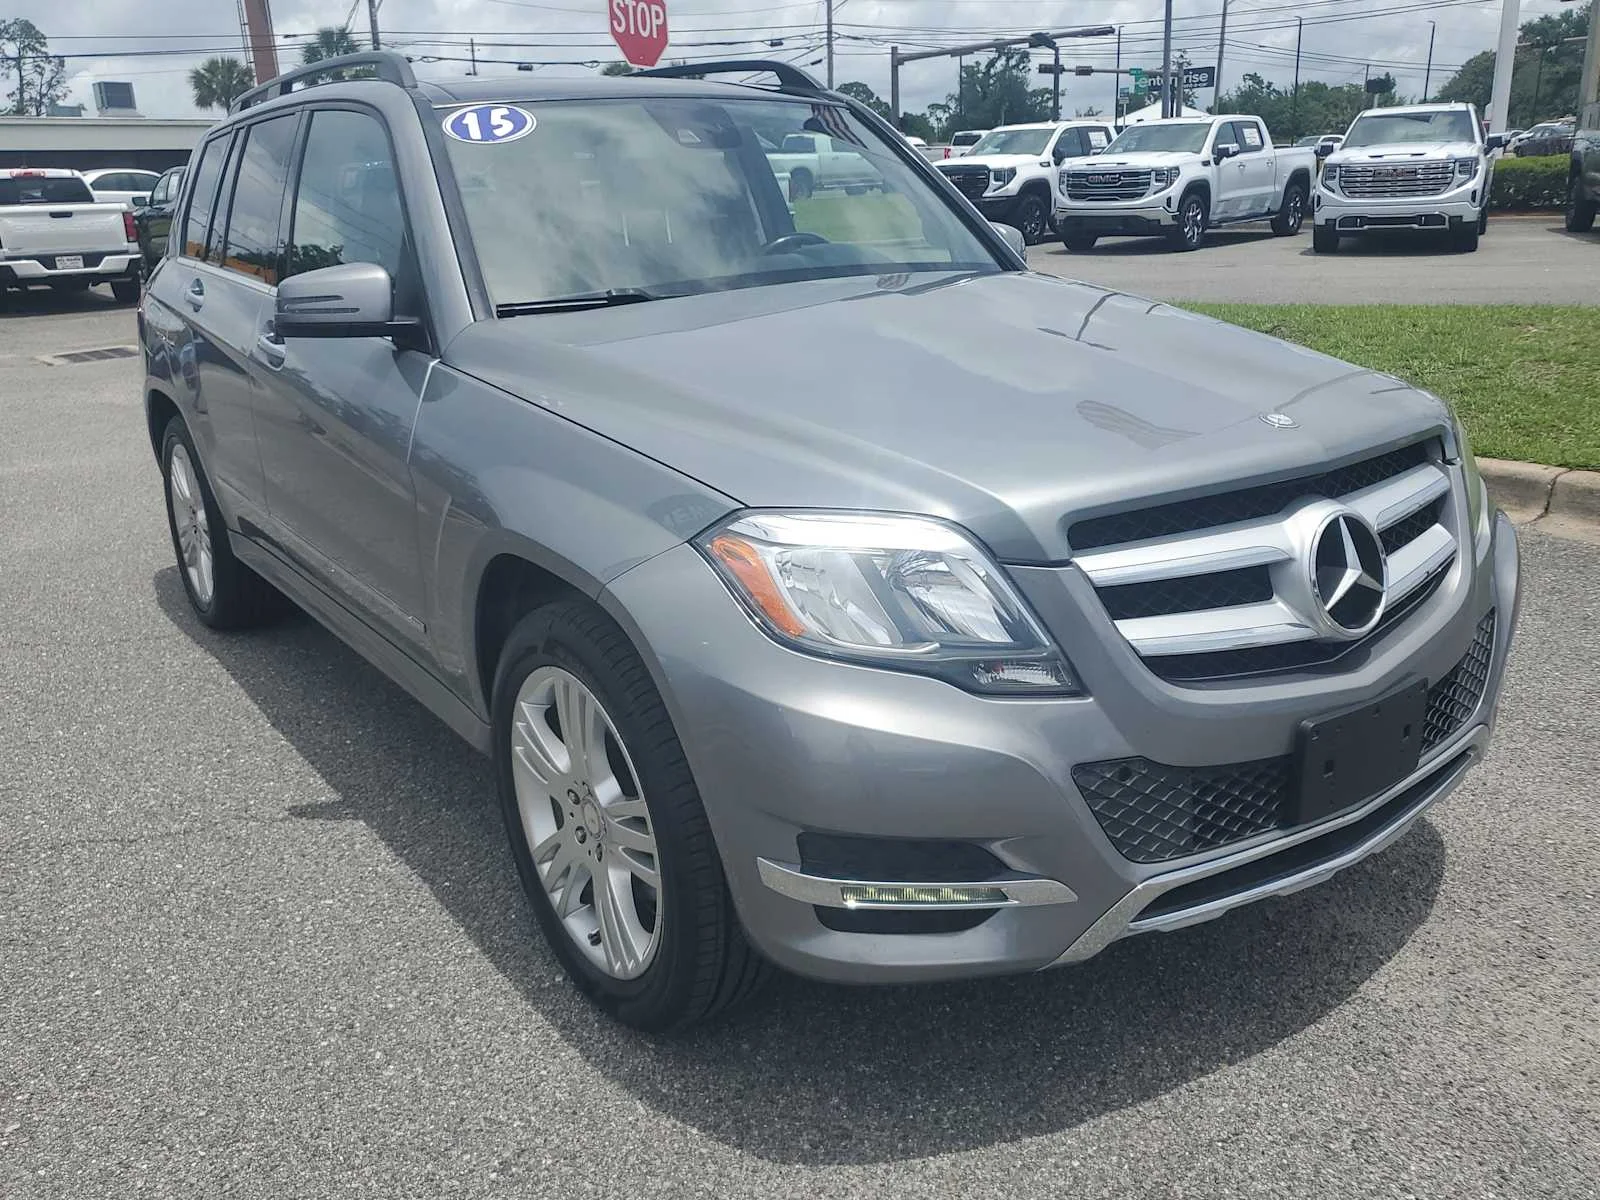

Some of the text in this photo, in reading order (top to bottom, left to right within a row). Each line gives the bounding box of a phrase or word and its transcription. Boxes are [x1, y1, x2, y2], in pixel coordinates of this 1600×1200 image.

[612, 0, 664, 38] STOP
[463, 107, 514, 140] 15
[1088, 174, 1119, 184] GMC
